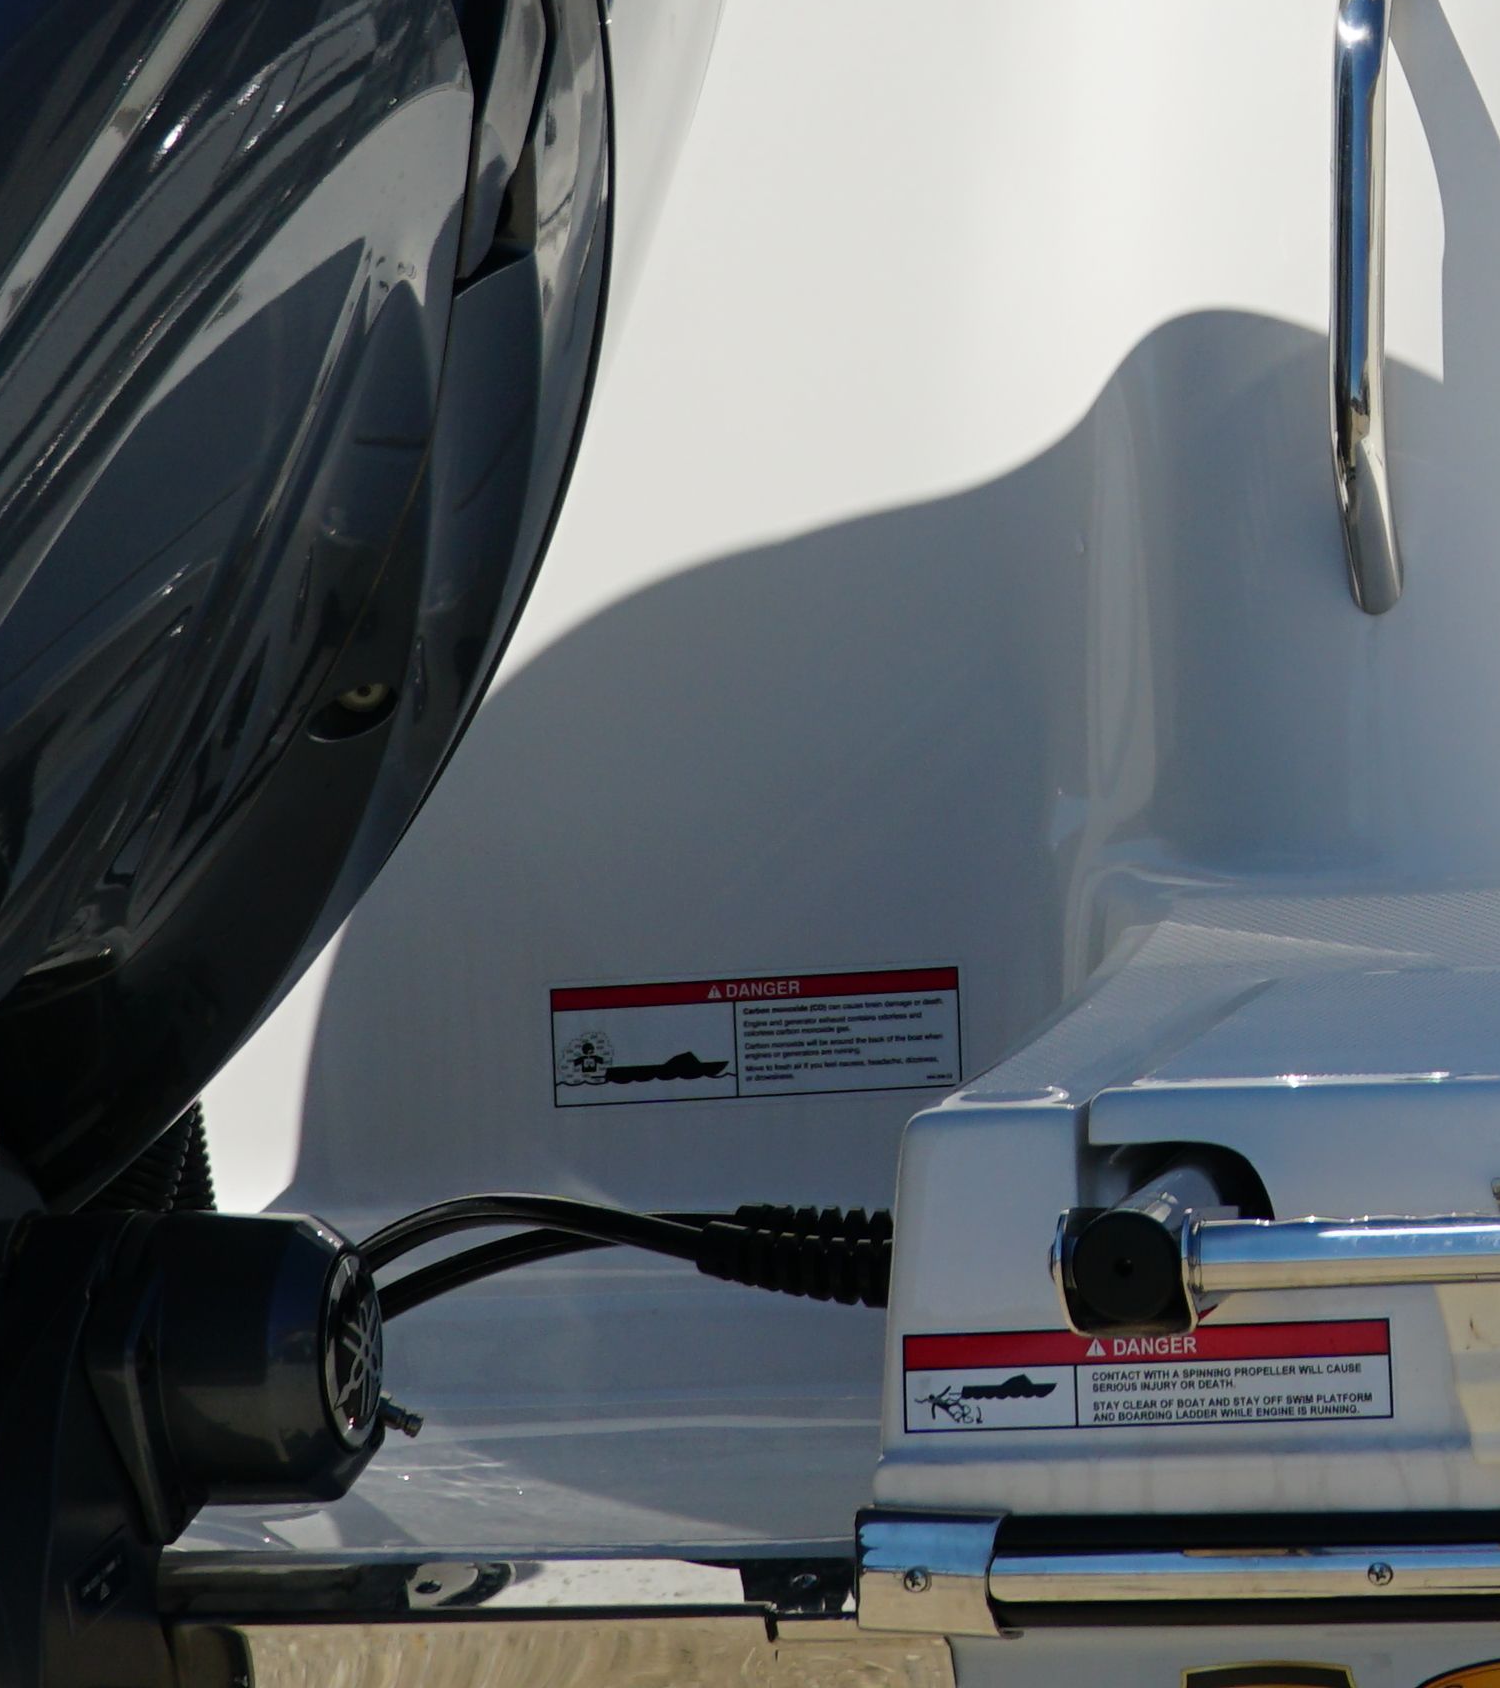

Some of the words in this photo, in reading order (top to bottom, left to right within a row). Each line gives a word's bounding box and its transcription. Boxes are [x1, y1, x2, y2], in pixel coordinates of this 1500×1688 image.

[725, 980, 800, 999] DANGER
[1113, 1336, 1197, 1356] DANGER
[1092, 1370, 1140, 1381] CONTACT
[1144, 1369, 1170, 1380] WITH
[1172, 1369, 1179, 1378] A
[1182, 1367, 1231, 1378] SPINNING
[1234, 1365, 1296, 1377] PROPELLER
[1298, 1364, 1323, 1375] WILL
[1326, 1363, 1362, 1374] CAUSE
[1092, 1382, 1138, 1392] SERIOUS
[1140, 1381, 1177, 1391] INJURY
[1180, 1380, 1195, 1390] OR
[1198, 1379, 1236, 1389] DEATH.
[1093, 1400, 1120, 1411] STAY
[1122, 1399, 1157, 1410] CLEAR
[1160, 1399, 1174, 1409] OF
[1177, 1398, 1205, 1408] BOAT
[1209, 1397, 1230, 1407] AND
[1233, 1396, 1260, 1407] STAY
[1263, 1395, 1283, 1406] OFF
[1286, 1394, 1313, 1405] SWIM
[1316, 1392, 1373, 1404] PLATFORM
[1093, 1412, 1115, 1422] AND
[1118, 1410, 1172, 1421] BOARDING
[1176, 1408, 1217, 1419] LADDER
[1221, 1408, 1252, 1419] WHILE
[1256, 1406, 1295, 1417] ENGINE
[1298, 1406, 1307, 1416] IS
[1310, 1404, 1360, 1415] RUNNING.
